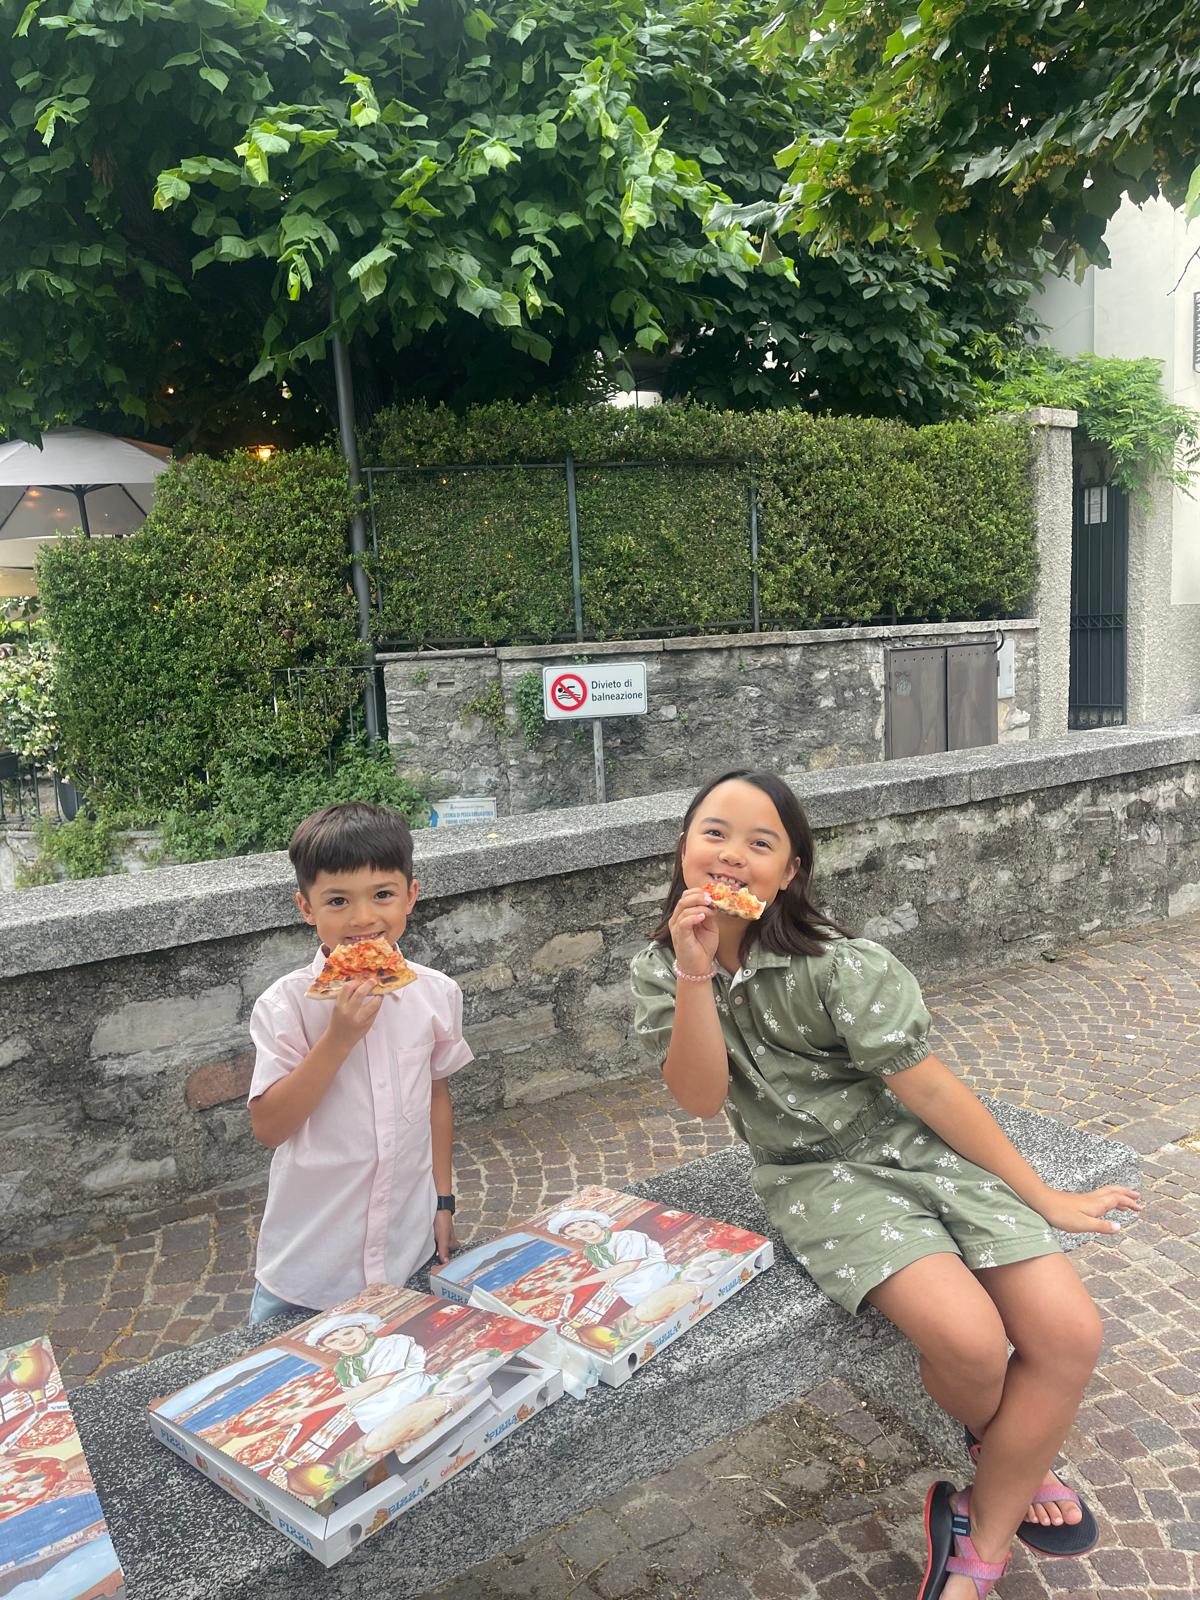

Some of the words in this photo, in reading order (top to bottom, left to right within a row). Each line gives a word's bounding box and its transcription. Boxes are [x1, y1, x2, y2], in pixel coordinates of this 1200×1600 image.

[591, 680, 622, 690] Divieto
[624, 679, 633, 688] di
[591, 691, 643, 701] balneazione
[486, 1414, 518, 1440] PIZZA
[160, 1428, 188, 1455] PIZZA
[388, 1485, 424, 1516] PIZZA
[278, 1517, 315, 1551] PIZZA
